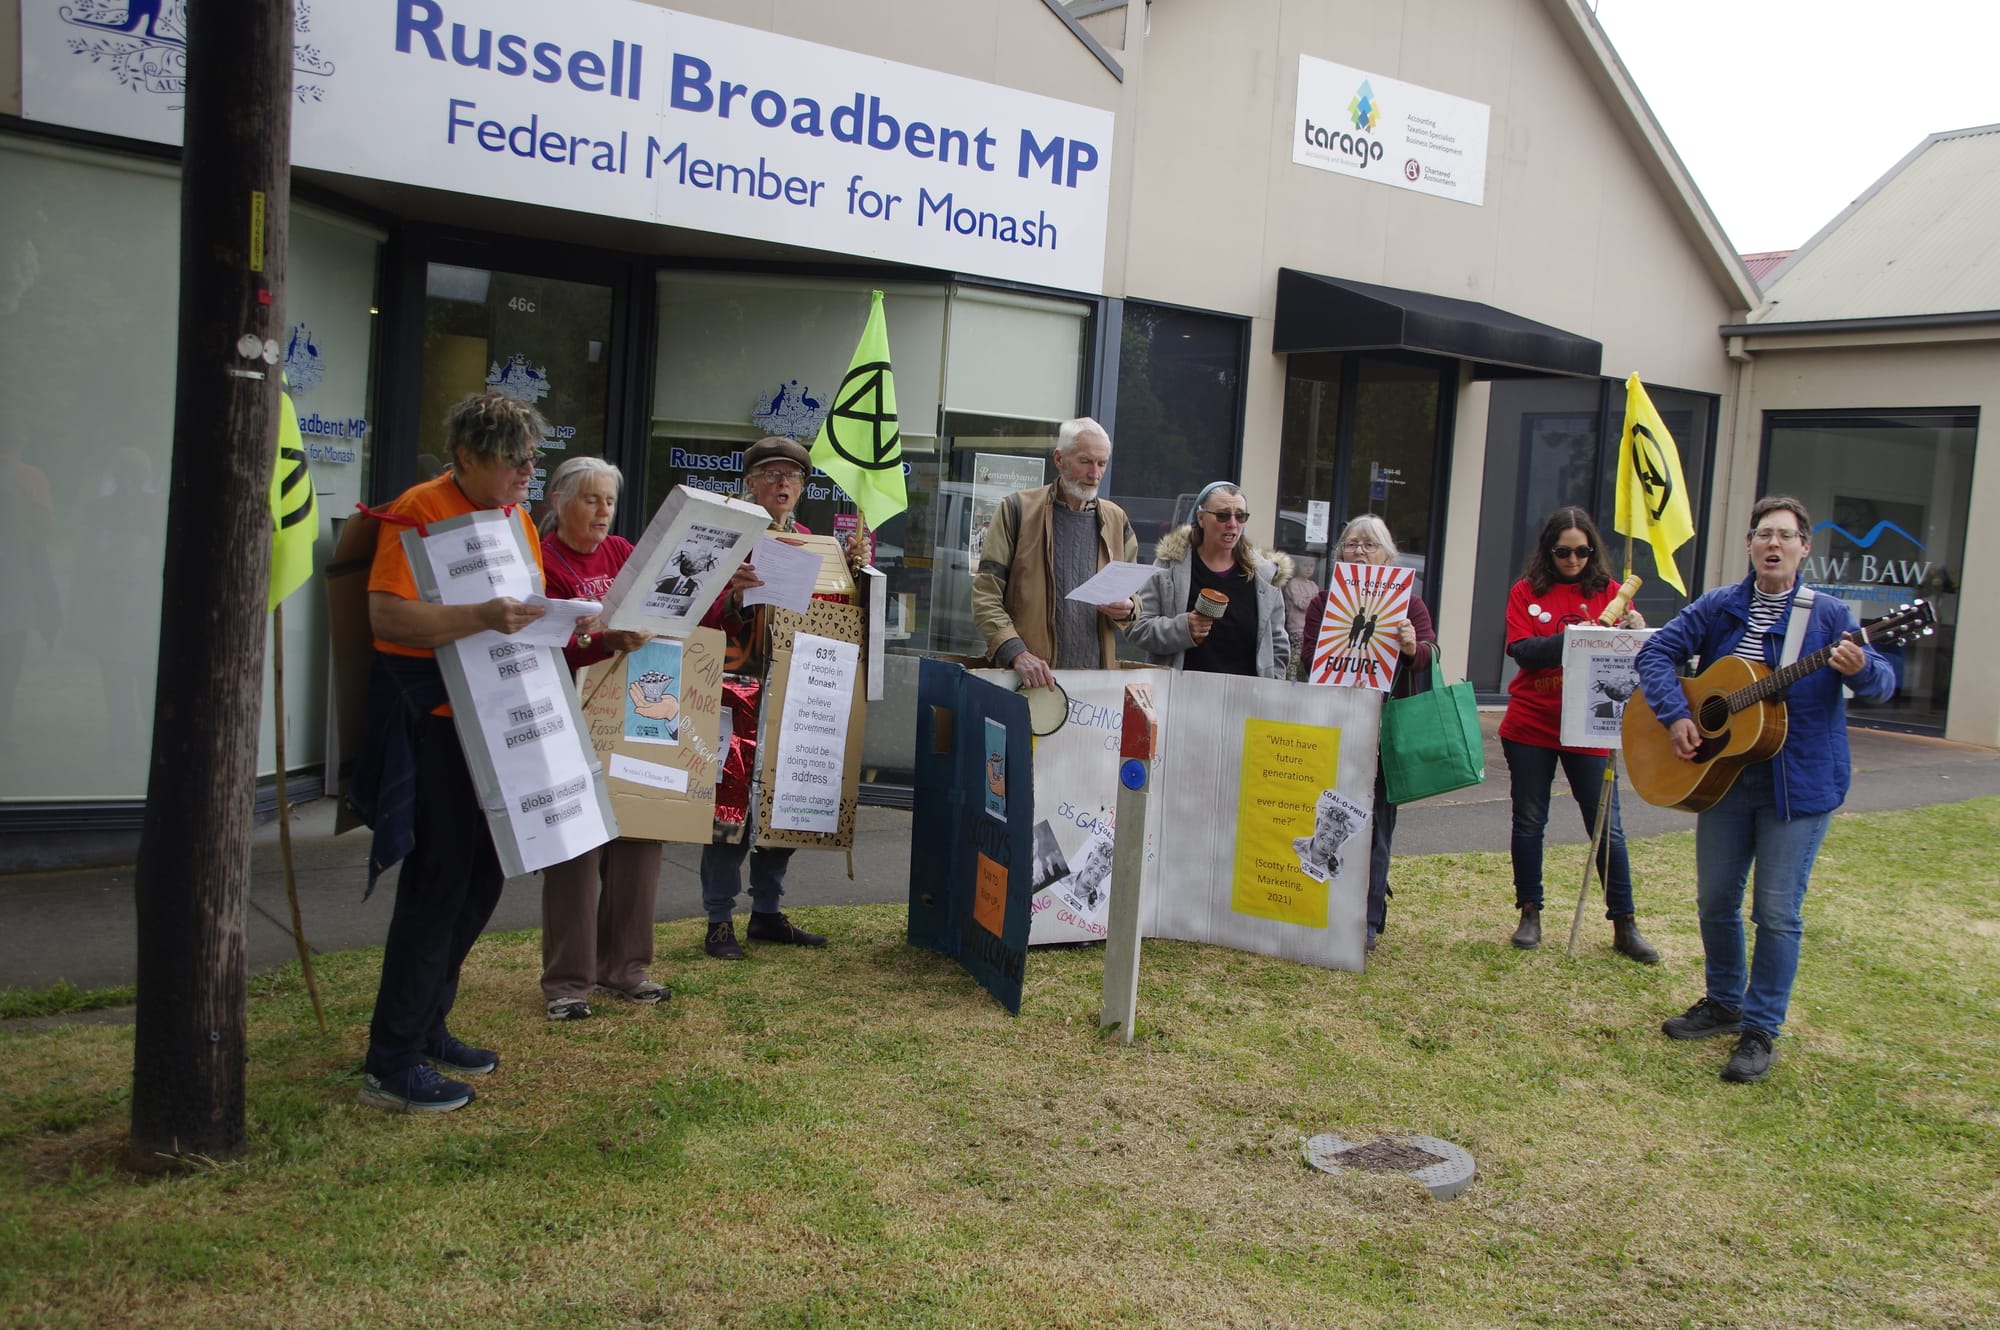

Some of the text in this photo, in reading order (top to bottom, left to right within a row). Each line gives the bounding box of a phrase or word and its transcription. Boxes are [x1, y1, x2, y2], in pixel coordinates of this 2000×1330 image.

[395, 0, 1099, 188] Russell Broadbent MP
[1407, 114, 1436, 128] Accounting
[1407, 125, 1455, 143] Taxation Specialists
[1305, 118, 1384, 168] tarago
[1406, 136, 1462, 156] Business Development
[447, 98, 1057, 250] Federal Member for Monash
[1424, 165, 1450, 178] Chartered
[1424, 173, 1456, 187] Accountants
[508, 297, 536, 312] 46c
[300, 413, 367, 438] adbent MP
[557, 427, 575, 438] MP
[310, 444, 355, 463] for Monash
[671, 448, 743, 472] Russell
[687, 475, 740, 495] Federal
[807, 484, 830, 499] for
[709, 528, 723, 536] WHAT
[1802, 554, 1933, 585] AW BAW
[1364, 578, 1406, 591] decisions
[1570, 639, 1614, 649] EXTINCTION
[816, 648, 837, 662] 63%
[498, 656, 538, 678] PROJECTS
[683, 643, 721, 688] PLAN
[803, 662, 843, 676] of people in
[1325, 656, 1379, 675] FUTURE
[807, 676, 837, 690] Monash
[682, 687, 716, 715] MORE
[807, 695, 832, 708] believe
[512, 702, 553, 722] That could
[799, 708, 836, 722] the federal
[794, 722, 836, 736] government
[506, 727, 546, 748] produce
[1295, 739, 1317, 751] have
[795, 744, 830, 756] should be
[678, 747, 709, 777] FIRE
[787, 755, 835, 770] doing more to
[1276, 752, 1303, 765] future
[791, 771, 828, 784] address
[1262, 768, 1314, 783] generations
[521, 780, 586, 813] global industrial
[781, 792, 834, 807] climate change
[1256, 798, 1315, 813] ever done for
[1323, 789, 1368, 820] COAL-O-PHILE
[544, 802, 583, 824] emissions
[1076, 812, 1101, 835] GAS
[1255, 857, 1284, 873] (Scotty
[1258, 874, 1304, 892] Marketing,
[1267, 892, 1292, 906] 2021)
[1056, 909, 1075, 926] COAL
[1079, 918, 1087, 928] IS
